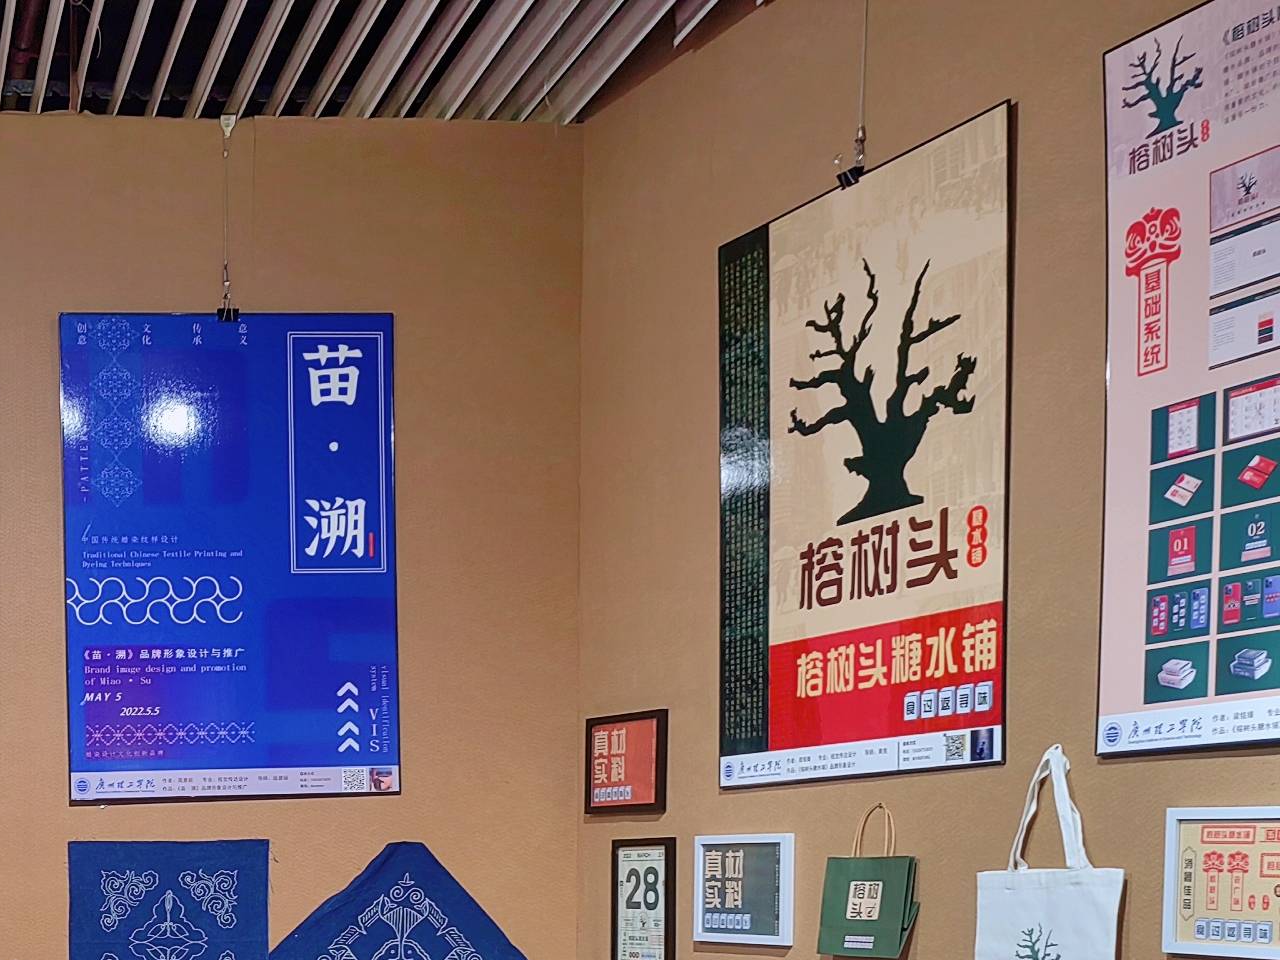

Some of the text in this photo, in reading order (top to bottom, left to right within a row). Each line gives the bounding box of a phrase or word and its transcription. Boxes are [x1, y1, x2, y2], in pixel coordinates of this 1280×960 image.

[1128, 123, 1199, 175] 榕树头
[1142, 269, 1162, 368] 基础系统
[1247, 521, 1266, 537] 02
[1173, 538, 1189, 553] 01
[83, 551, 127, 559] Traditional
[130, 550, 159, 558] Chinese
[194, 549, 227, 558] Printing
[799, 506, 959, 611] 榕树头
[139, 648, 246, 660] 品牌形象设计与推广
[796, 618, 998, 699] 榕树头糖水铺
[84, 664, 247, 675] Brand image design and promotion
[84, 678, 96, 686] of
[140, 677, 152, 685] Su
[84, 692, 122, 702] MAY 5
[120, 707, 161, 716] 2022.5.5
[625, 866, 659, 911] 28
